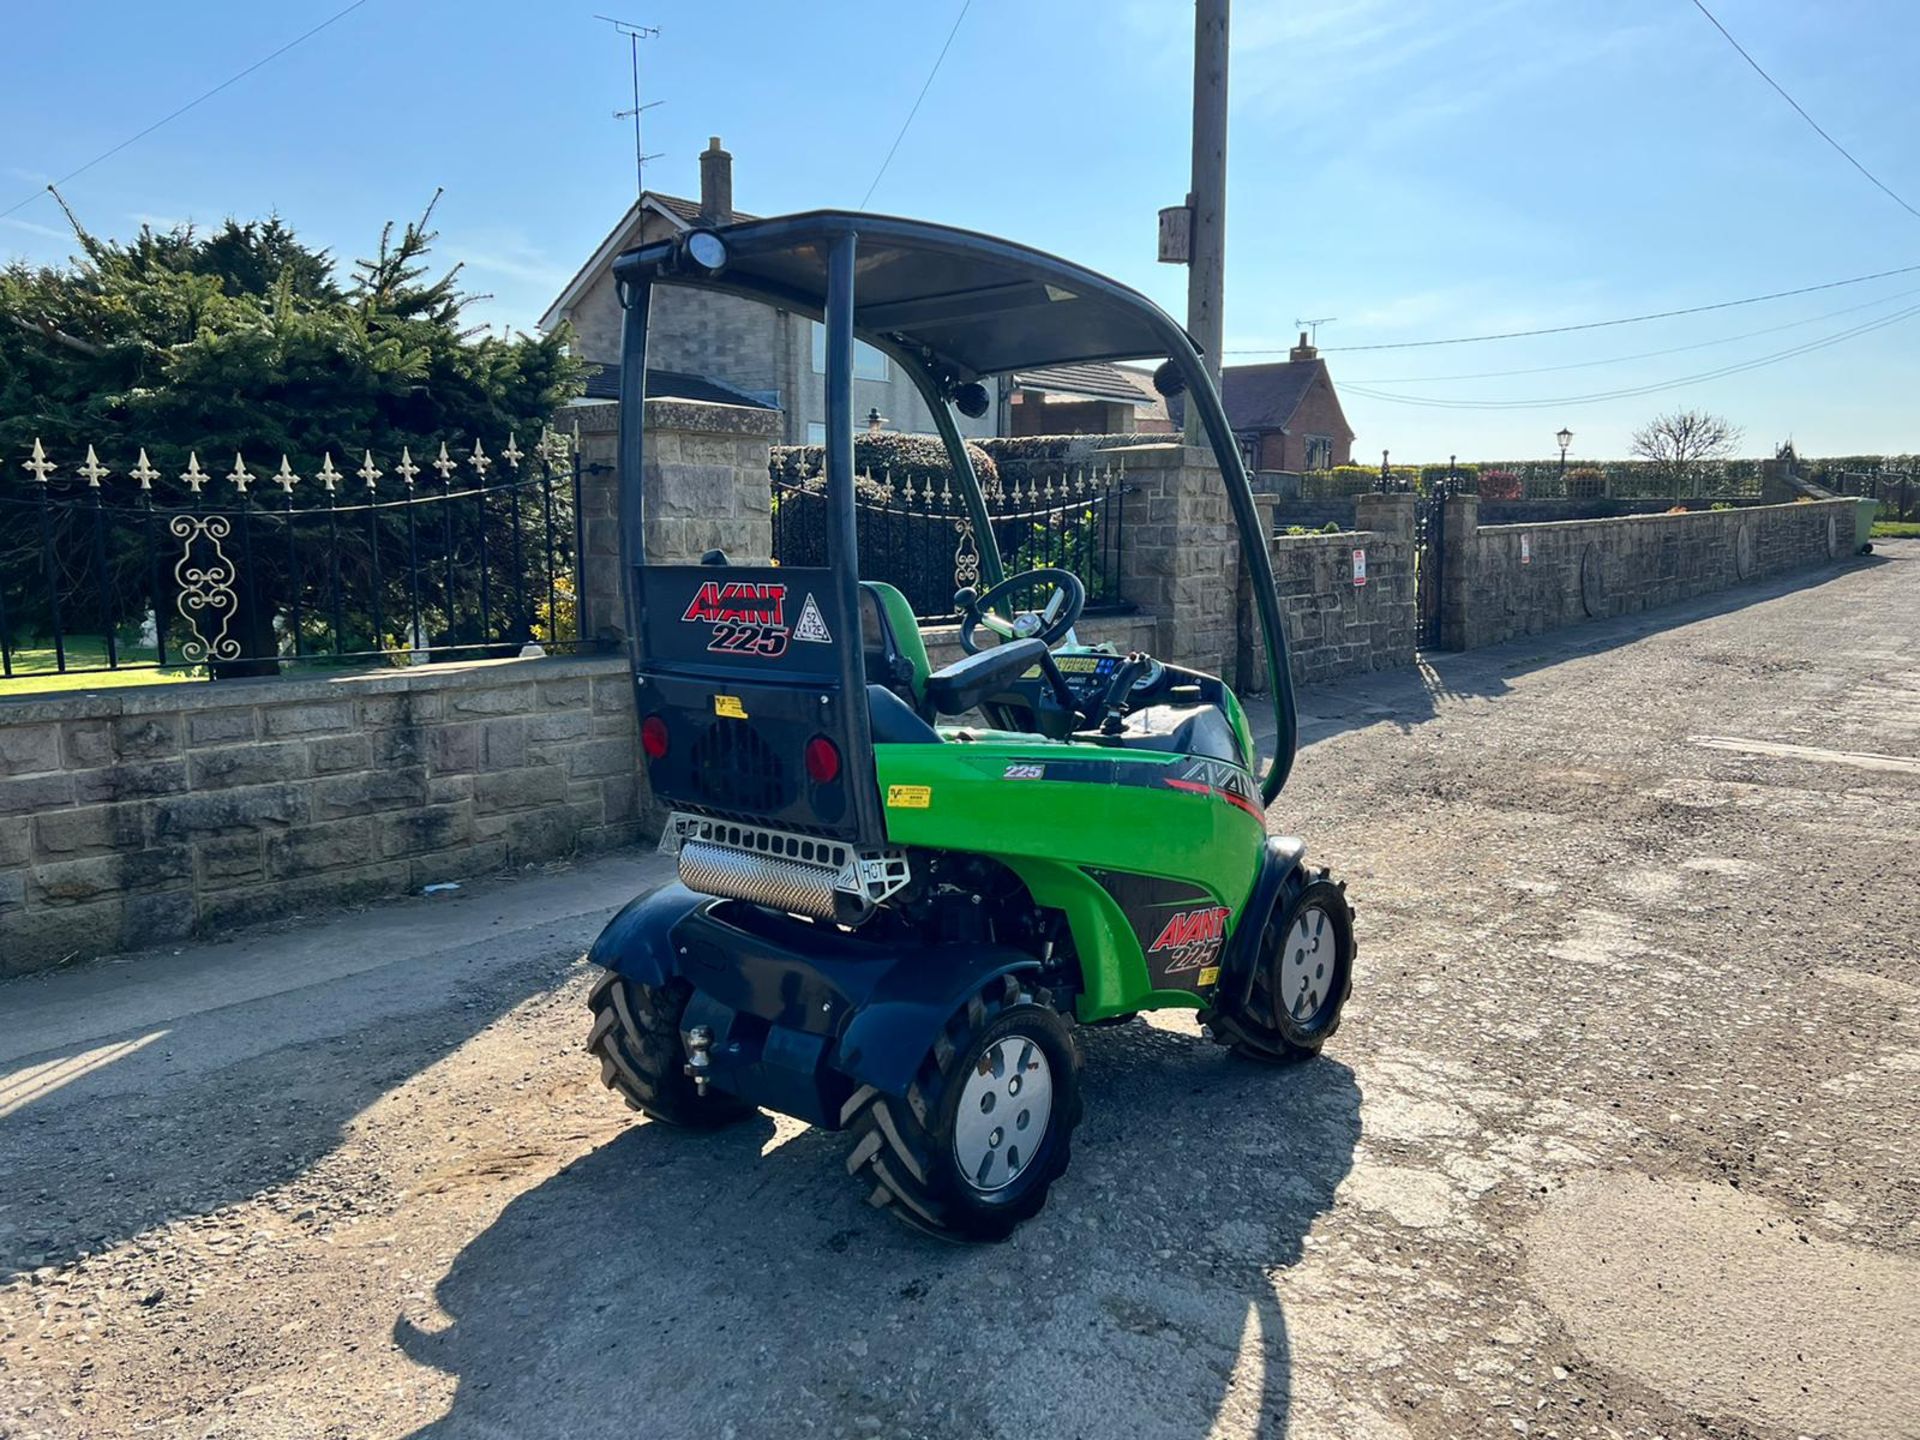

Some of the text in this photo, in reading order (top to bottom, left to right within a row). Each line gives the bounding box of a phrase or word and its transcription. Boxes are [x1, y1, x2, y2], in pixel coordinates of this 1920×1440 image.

[681, 581, 787, 626] AVANT
[707, 624, 790, 657] 225
[1003, 764, 1043, 779] 225
[862, 862, 884, 880] HOT
[1148, 906, 1232, 953] AVANT
[1164, 938, 1223, 974] 225
